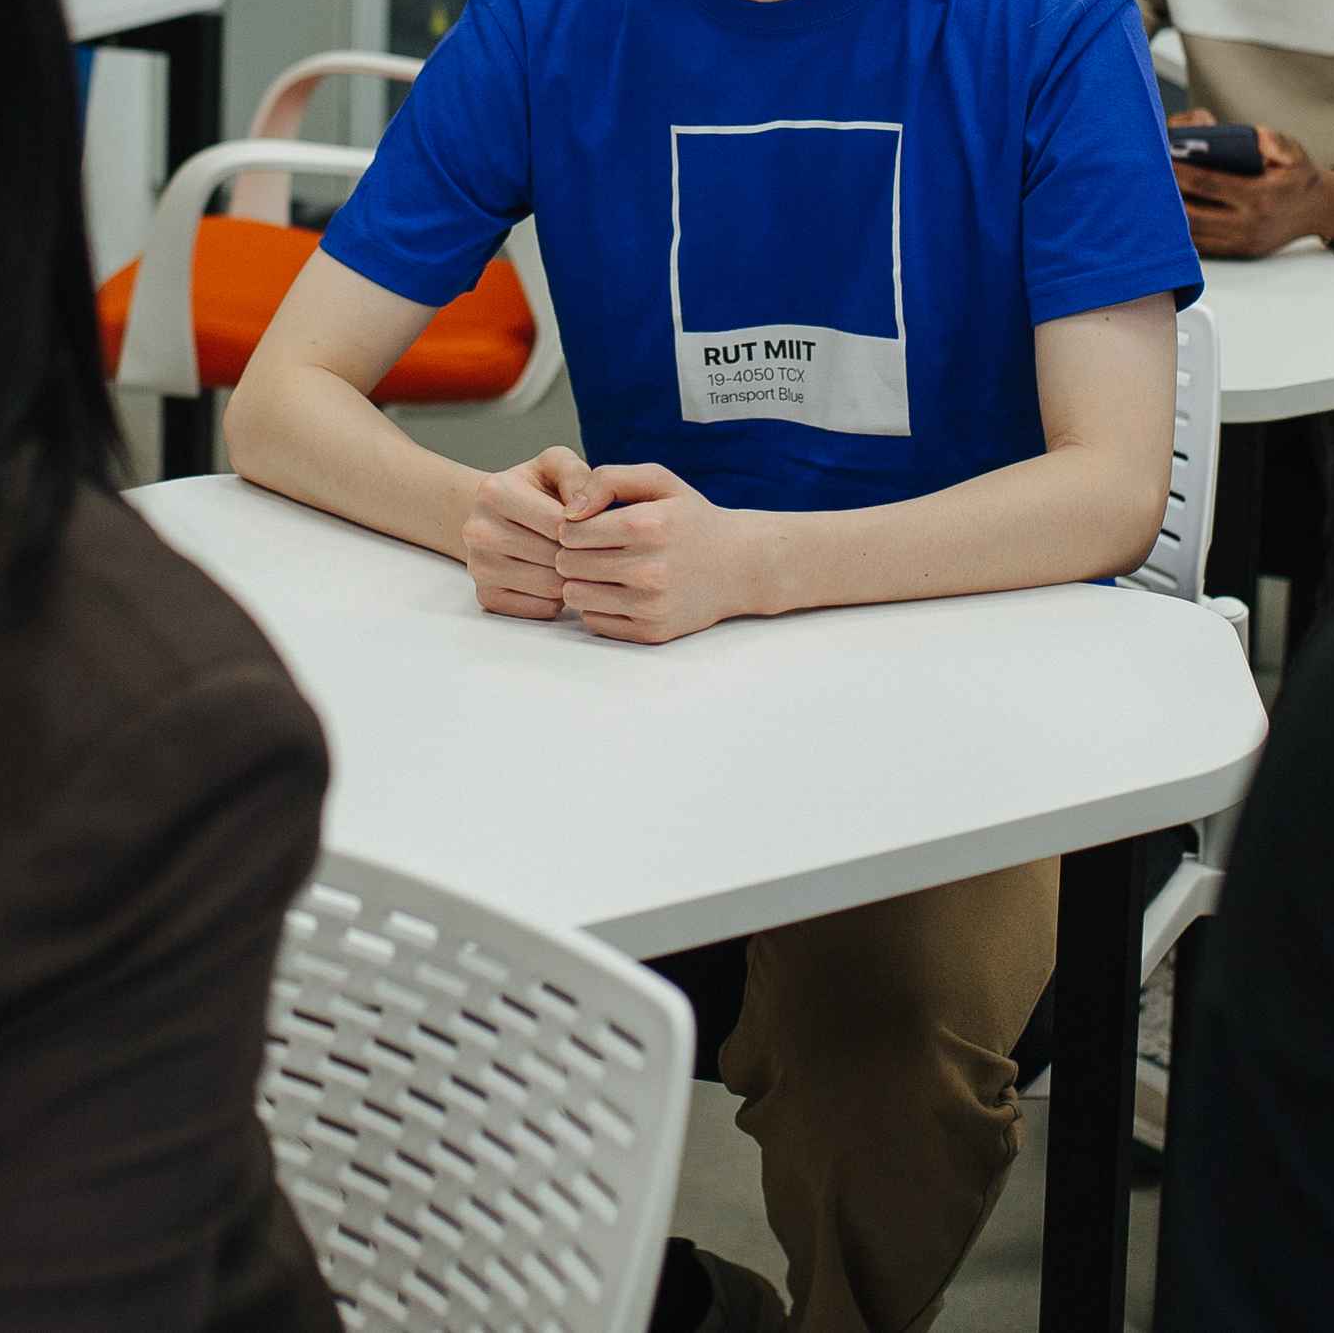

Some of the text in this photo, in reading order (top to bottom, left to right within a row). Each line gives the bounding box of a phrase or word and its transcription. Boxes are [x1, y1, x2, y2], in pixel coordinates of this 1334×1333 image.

[704, 340, 817, 366] RUT MIIT
[707, 367, 805, 386] 19-4050 TCX
[707, 387, 804, 405] Transport Blue
